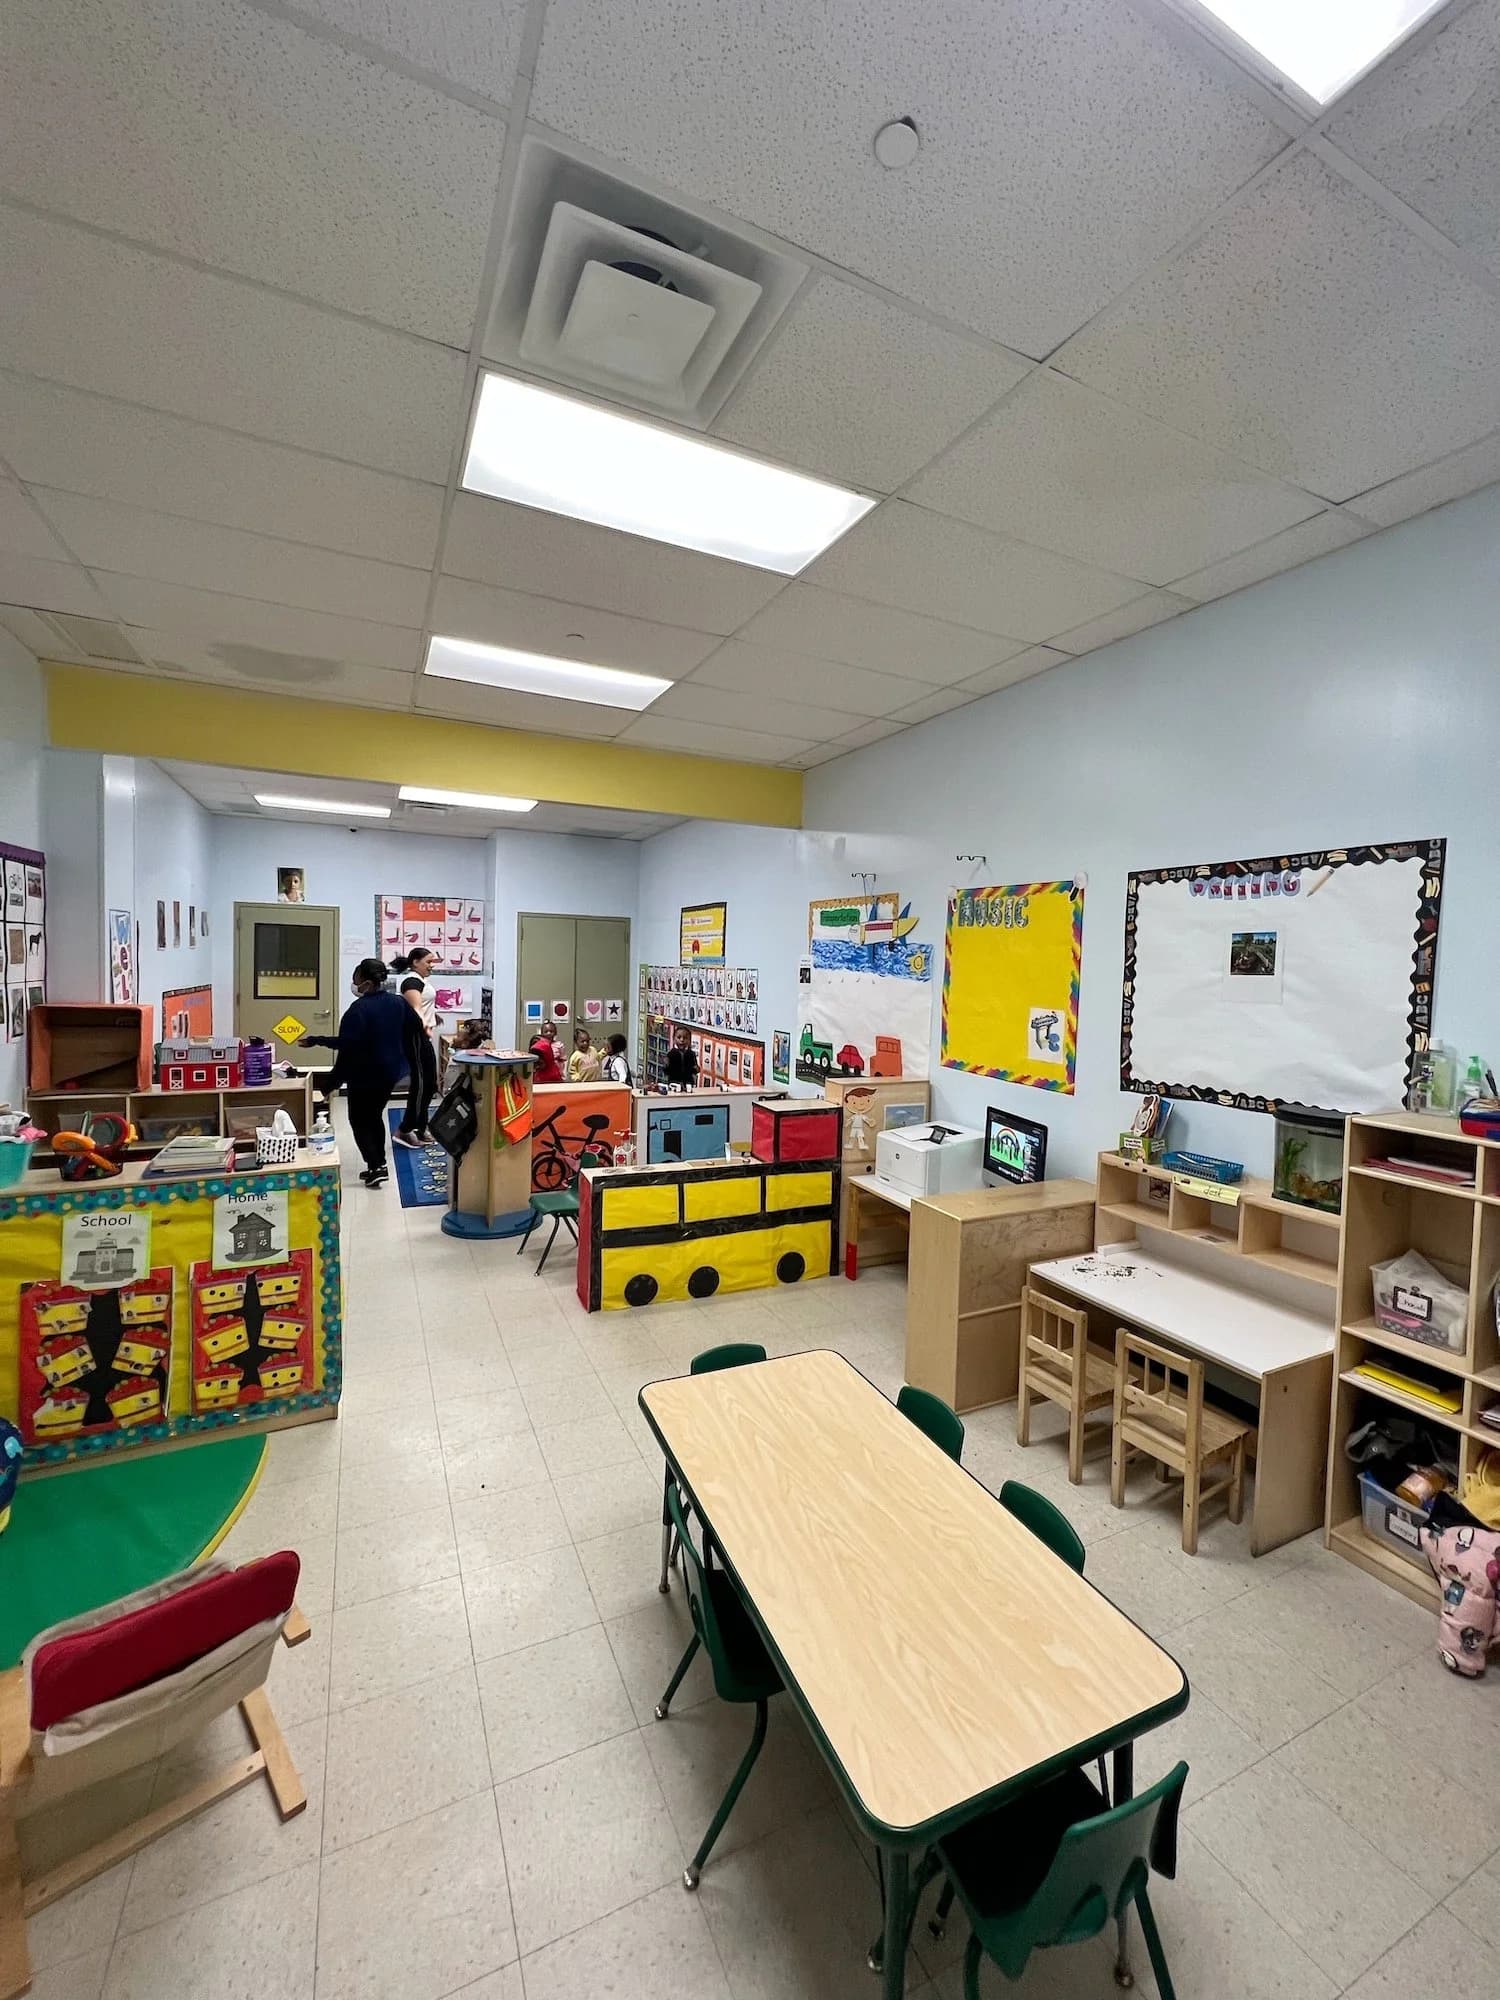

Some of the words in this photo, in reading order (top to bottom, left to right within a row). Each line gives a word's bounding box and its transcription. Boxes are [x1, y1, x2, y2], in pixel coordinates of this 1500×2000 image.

[958, 896, 1029, 928] MUSIC
[278, 1025, 301, 1034] SLOW
[1240, 1098, 1266, 1110] ABC
[228, 1191, 269, 1204] Home
[81, 1213, 132, 1227] School
